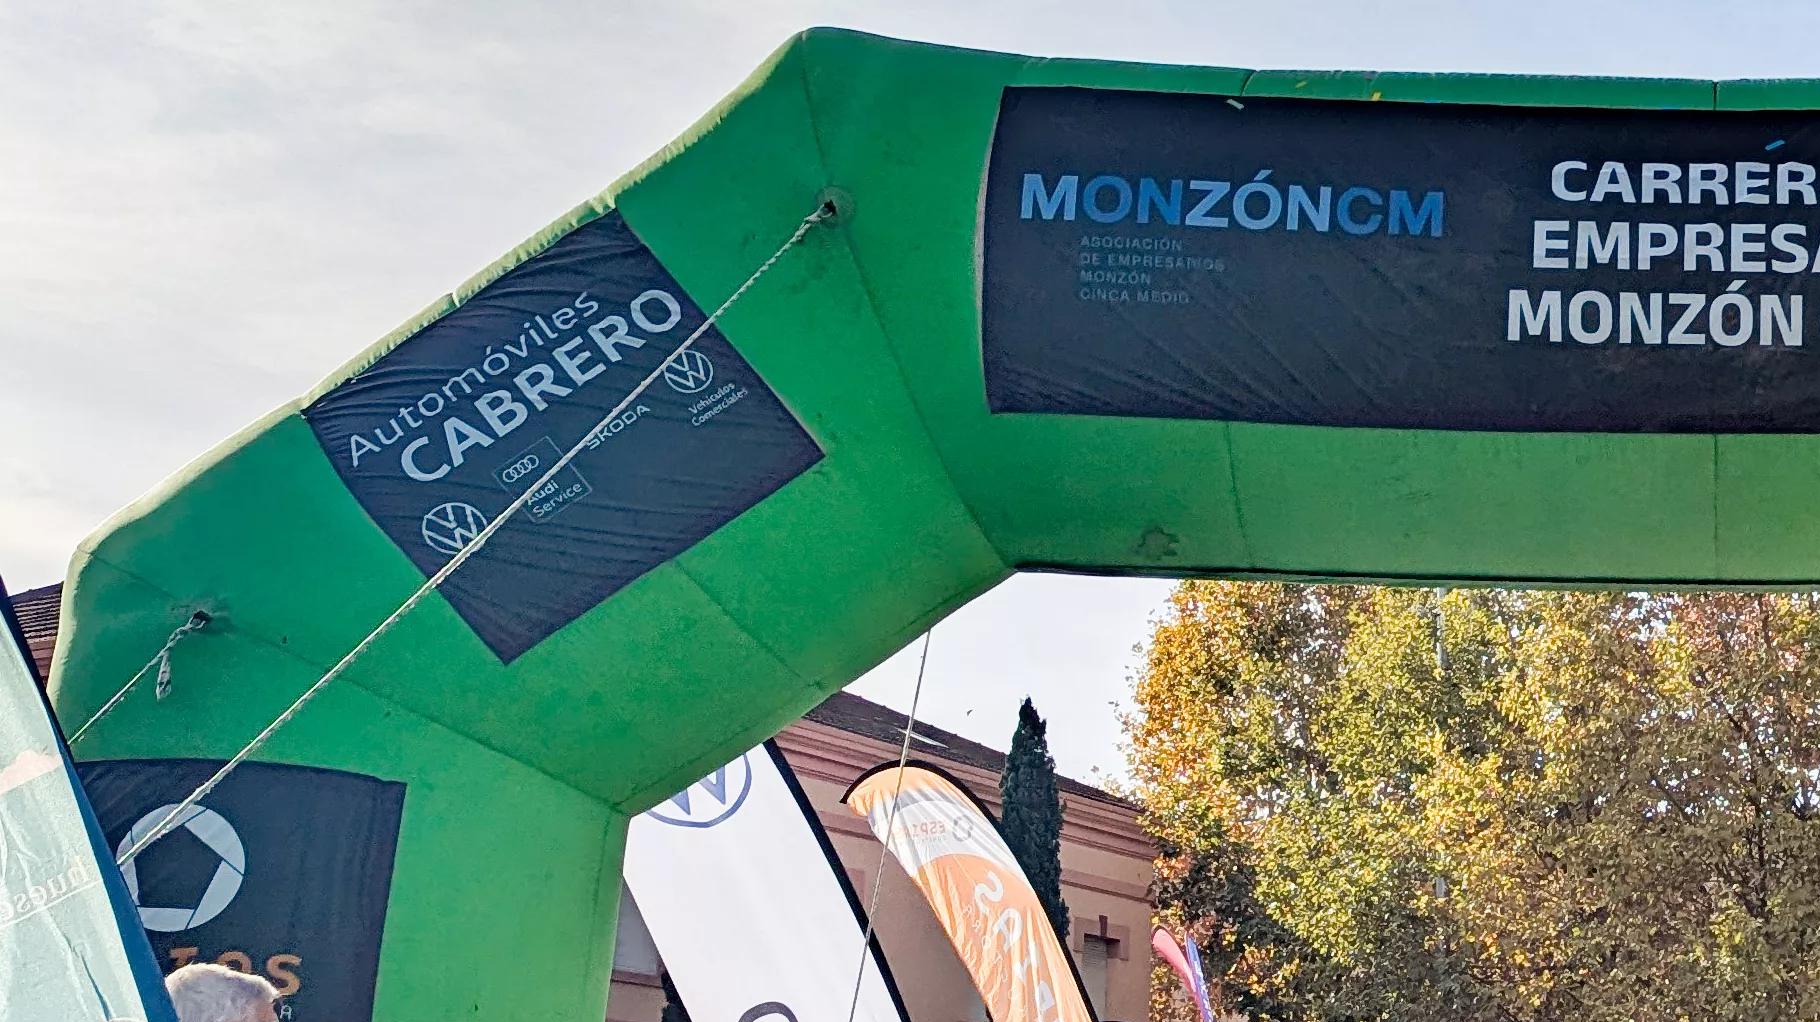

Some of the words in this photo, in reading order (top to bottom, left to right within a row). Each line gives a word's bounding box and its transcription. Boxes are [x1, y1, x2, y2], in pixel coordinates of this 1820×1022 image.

[1020, 169, 1445, 237] MONZÓNCM
[1079, 235, 1183, 251] ASOCIACIÓN
[1080, 253, 1101, 266] DE
[1080, 267, 1151, 286] MONZÓN
[1079, 288, 1130, 302] CINCA
[1136, 289, 1189, 304] MEDIO
[1507, 280, 1803, 347] MONZÓN
[349, 291, 599, 467] Automóviles
[401, 289, 681, 482] CABRERO
[527, 480, 559, 506] Audi
[532, 482, 583, 518] Service
